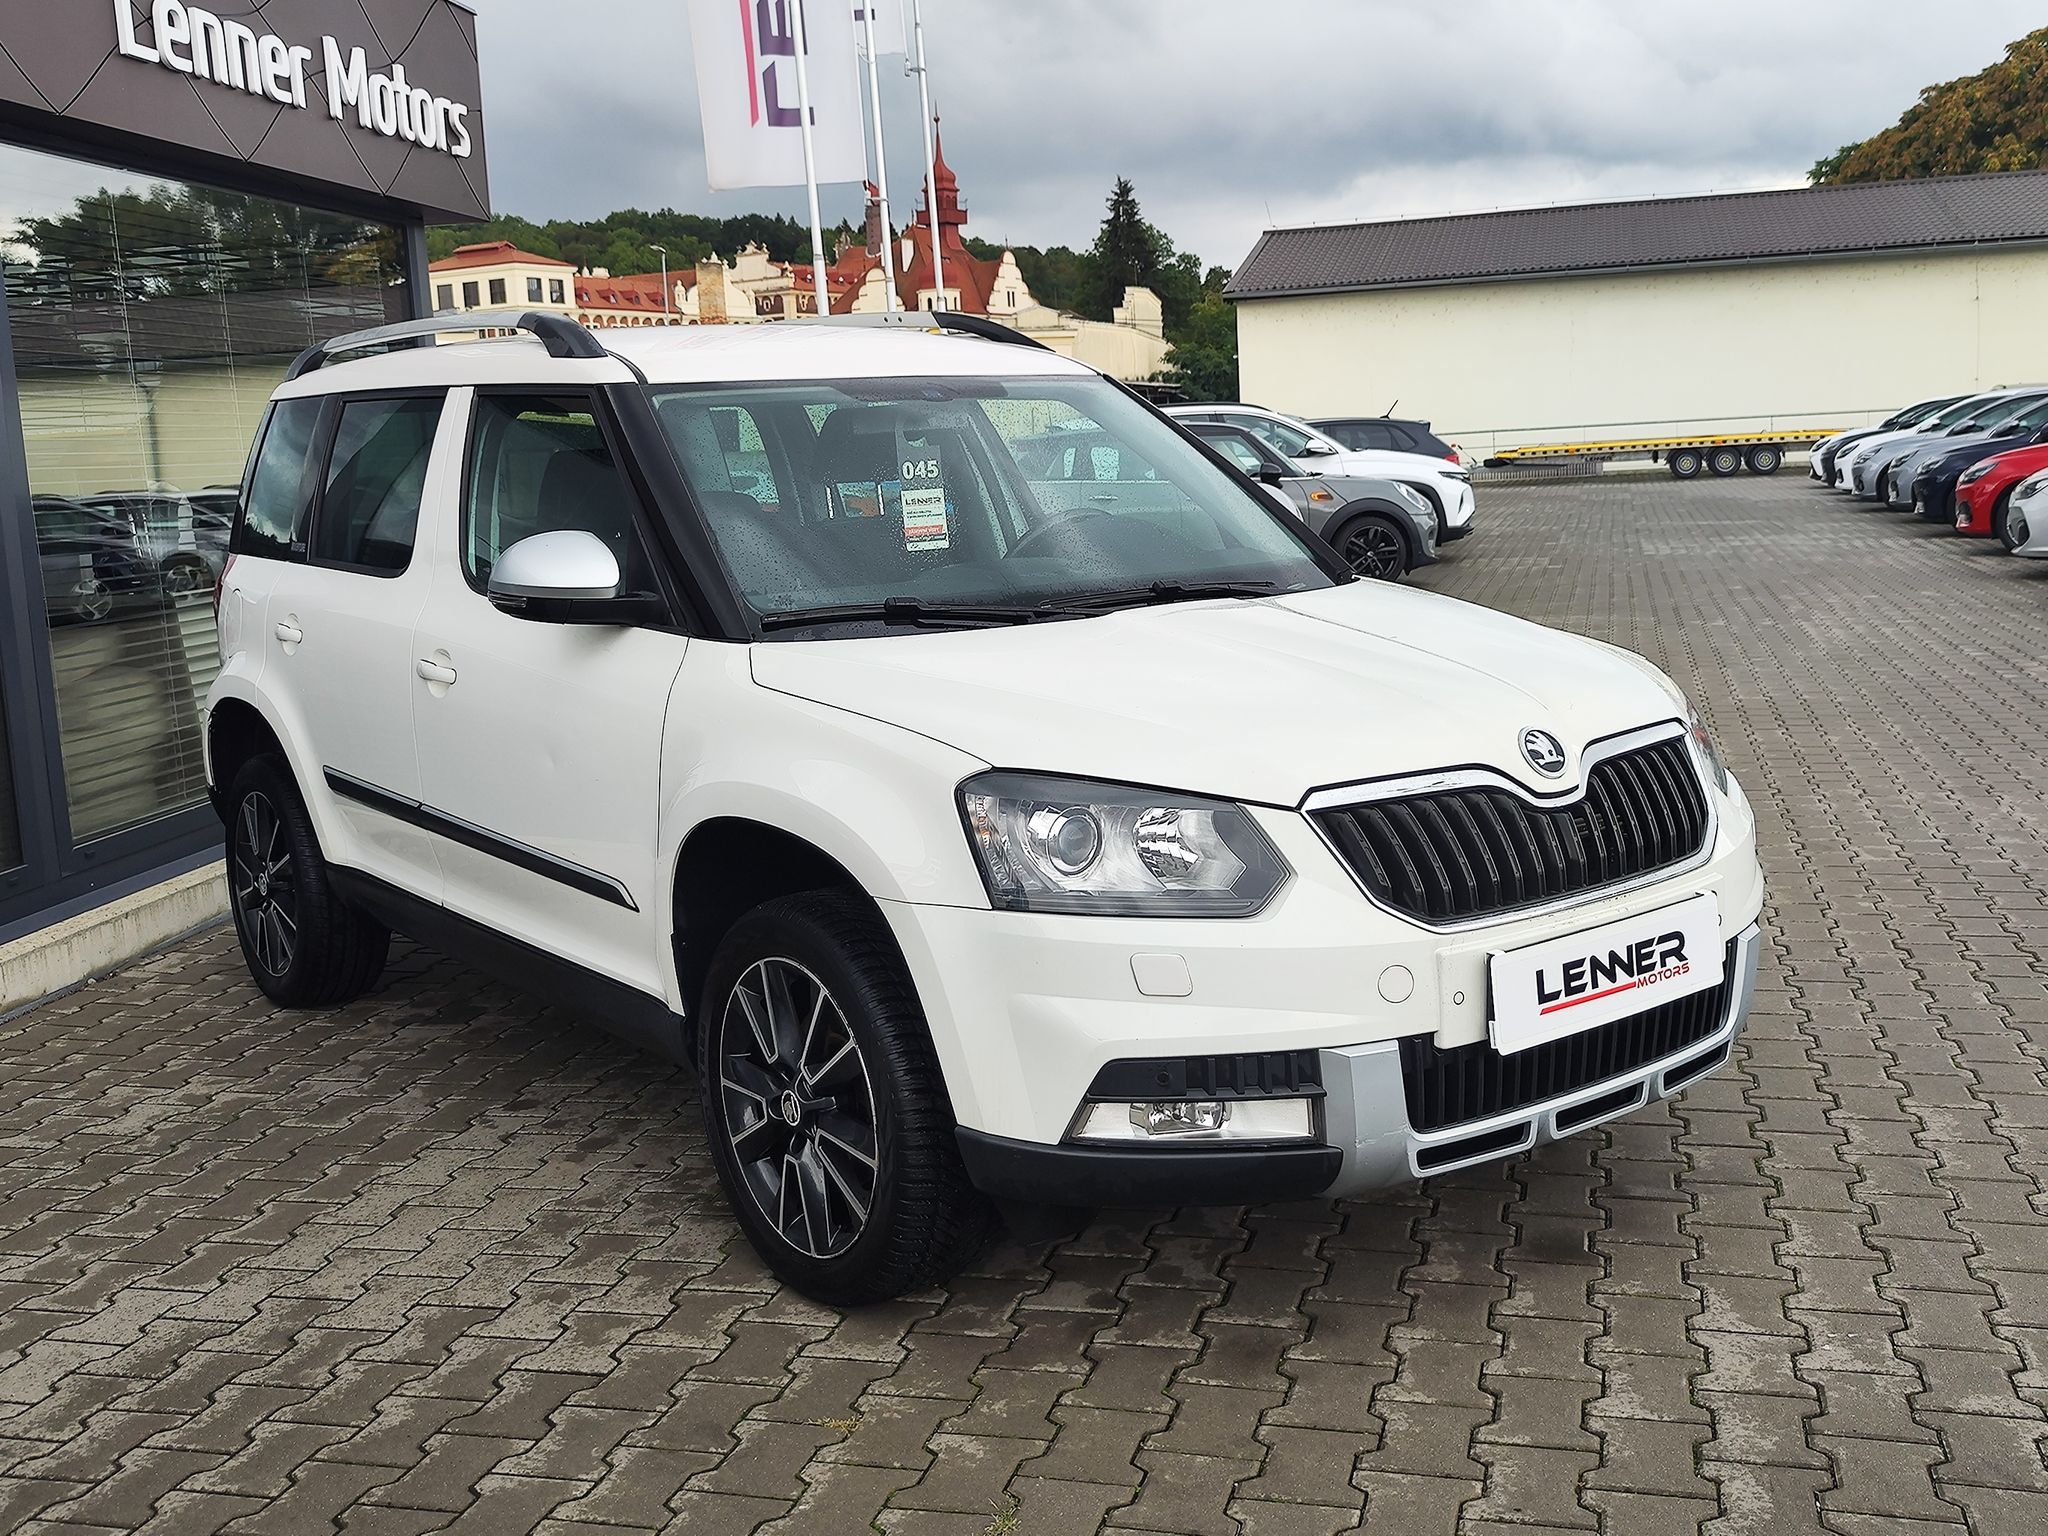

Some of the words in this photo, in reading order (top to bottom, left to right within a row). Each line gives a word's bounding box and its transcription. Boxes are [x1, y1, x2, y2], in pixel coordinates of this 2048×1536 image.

[114, 0, 312, 109] Lenner
[321, 35, 472, 158] Motors
[902, 460, 940, 480] 045
[1535, 930, 1689, 1005] LENNER
[1636, 962, 1691, 989] MOTORS
